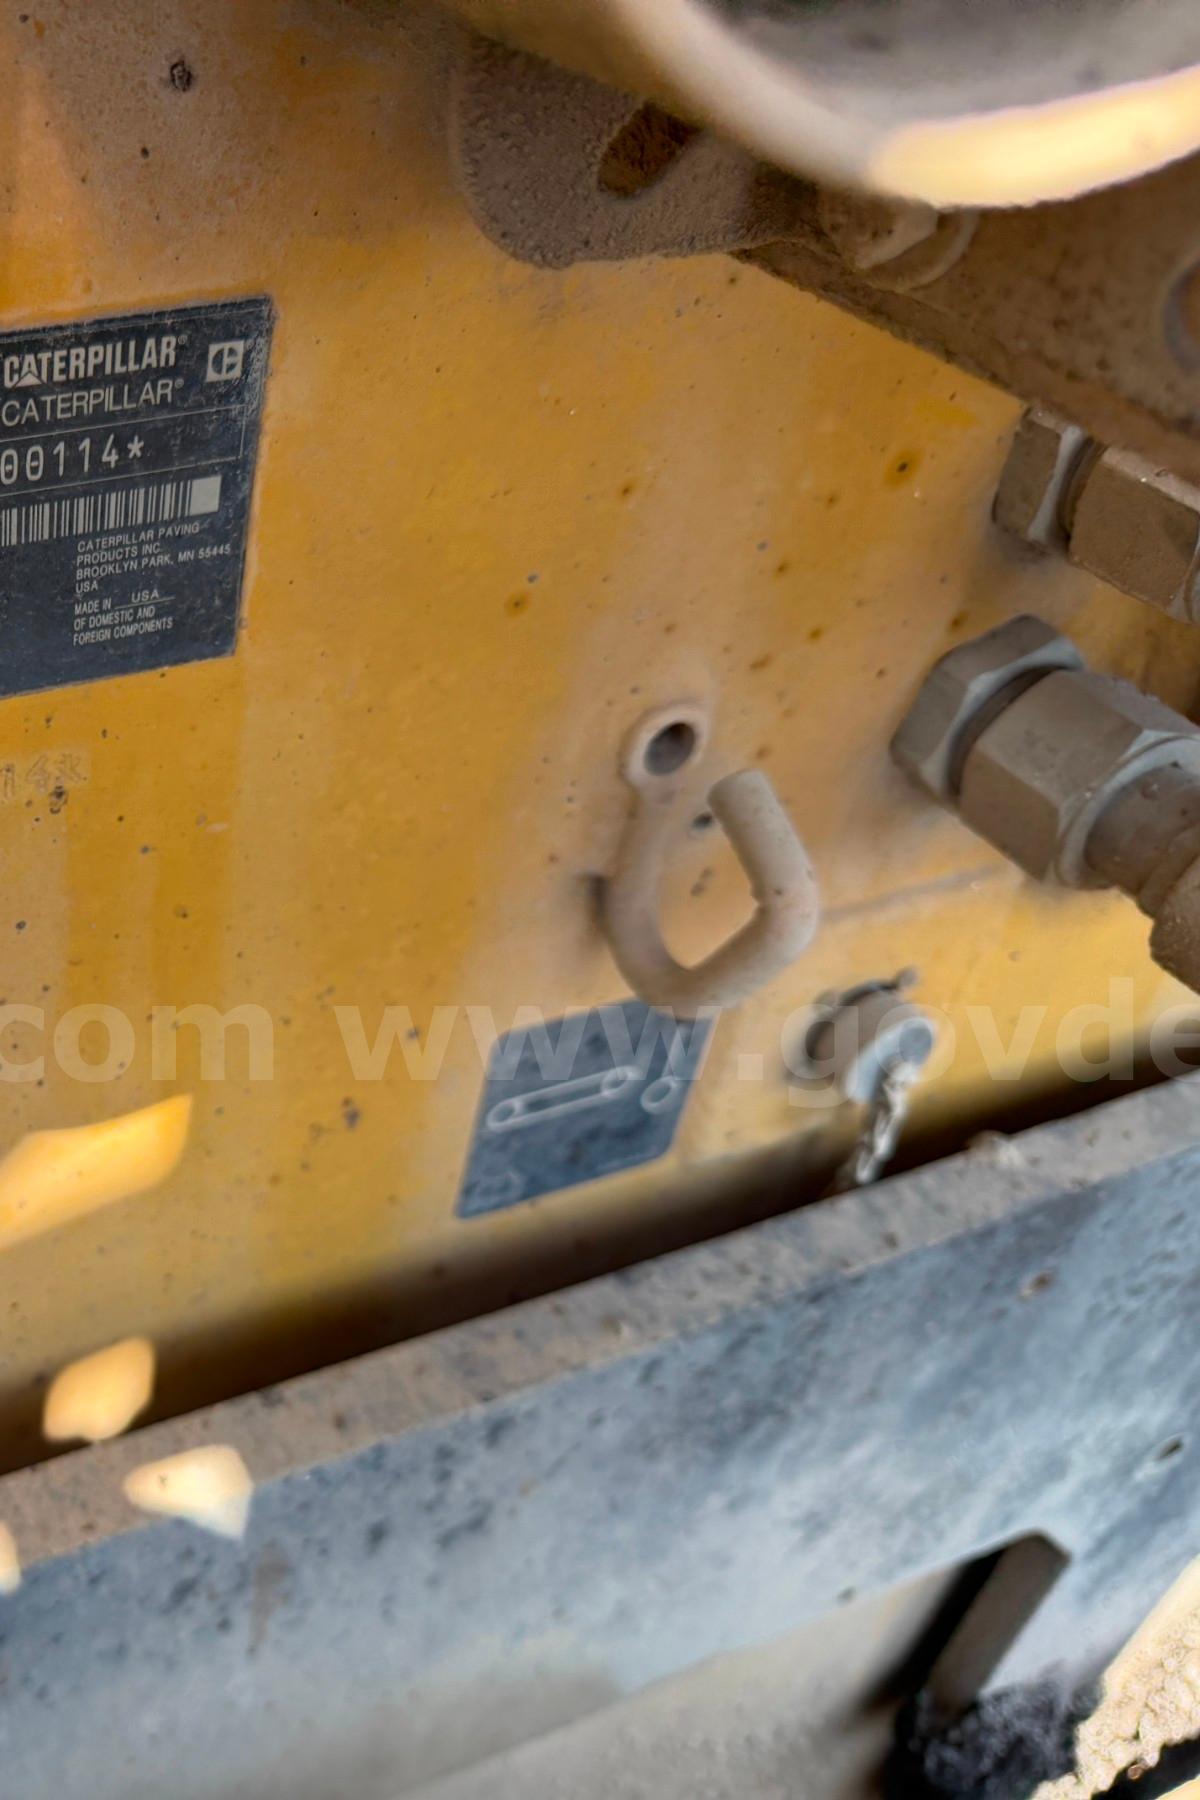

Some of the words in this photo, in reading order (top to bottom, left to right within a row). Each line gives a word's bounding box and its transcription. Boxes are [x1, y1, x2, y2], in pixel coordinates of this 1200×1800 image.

[77, 529, 154, 553] CATERPILLAR
[158, 522, 201, 537] PAVING
[76, 546, 138, 567] PRODUCTS
[76, 560, 138, 581] BROOKLYN
[178, 551, 195, 563] MN
[198, 543, 231, 560] 55445
[75, 580, 99, 594] USA
[74, 600, 99, 616] MADE
[102, 598, 112, 611] IN
[131, 588, 160, 603] USA
[73, 617, 86, 631] OF
[89, 609, 134, 629] DOMESTIC
[136, 605, 155, 619] AND
[73, 628, 112, 647] FOREIGN
[113, 616, 174, 640] COMPONENTS
